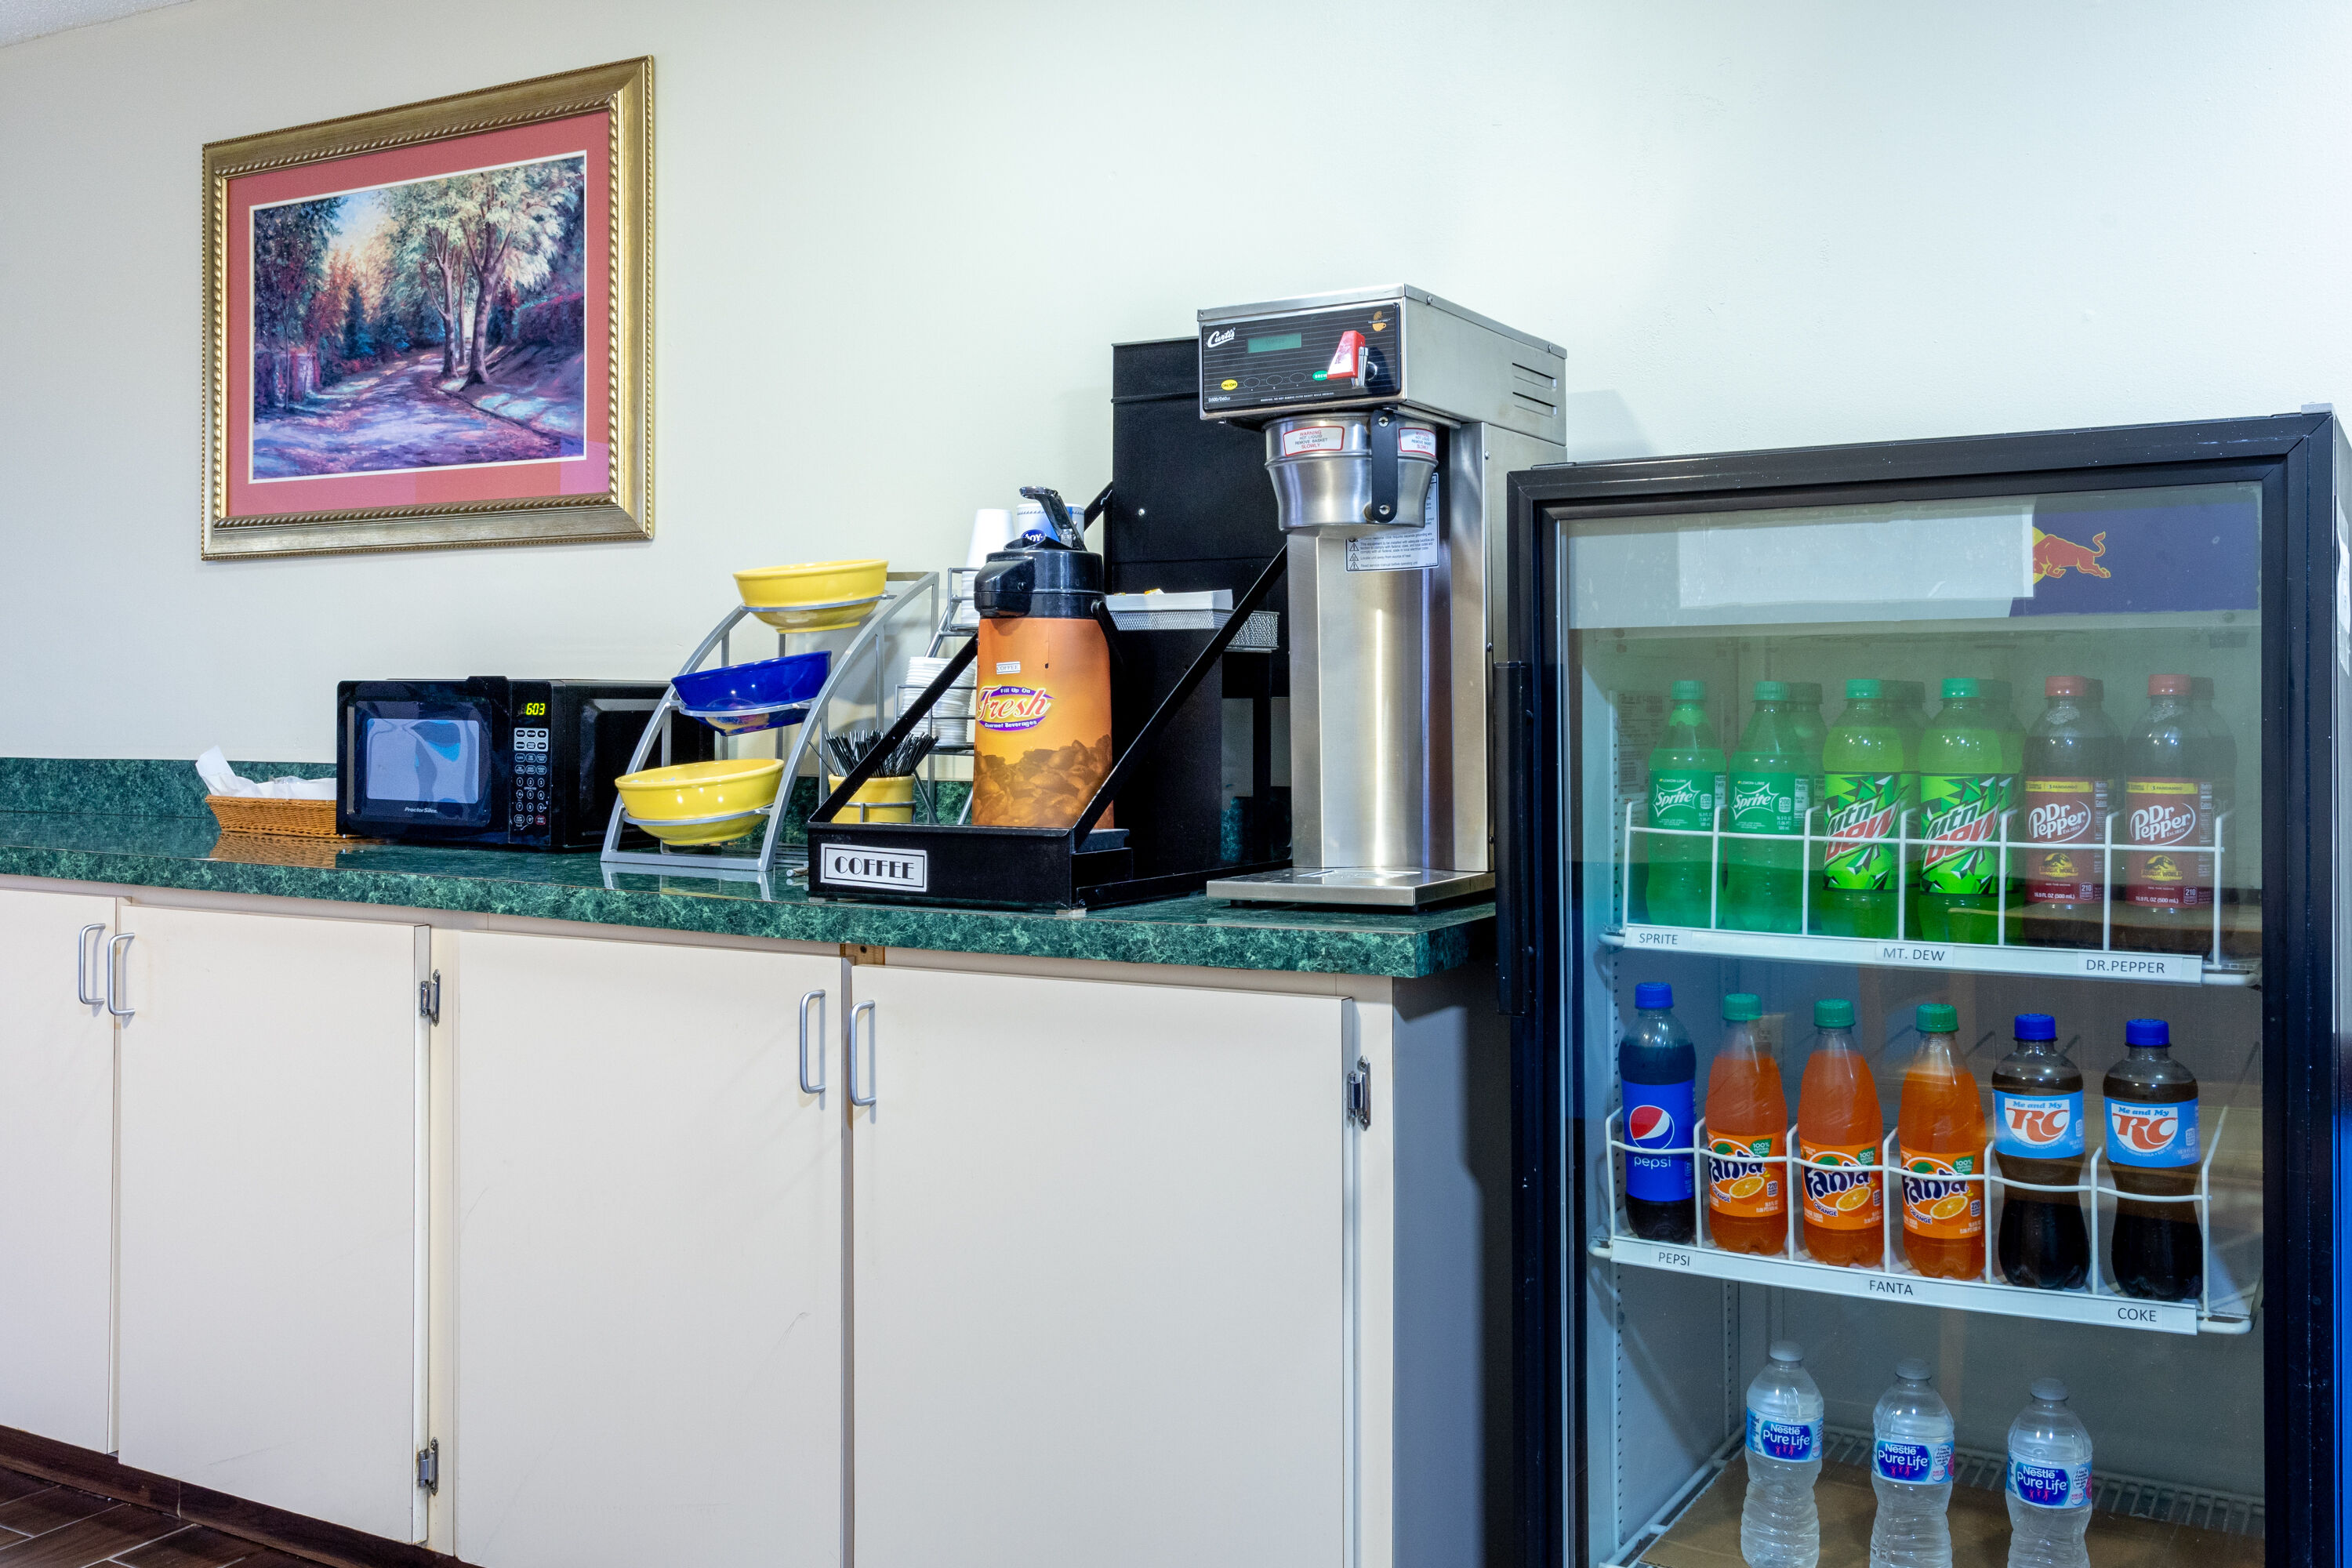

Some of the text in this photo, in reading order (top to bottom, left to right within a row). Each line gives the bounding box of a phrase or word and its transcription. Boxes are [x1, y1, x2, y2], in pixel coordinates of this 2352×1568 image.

[1207, 328, 1235, 347] Curtis
[977, 684, 1051, 721] Fresh
[1655, 790, 1693, 808] Sprite
[1733, 793, 1772, 810] Sprite
[2045, 803, 2071, 822] Dr
[2148, 804, 2175, 825] Dr
[2029, 808, 2086, 839] Pepper
[2130, 809, 2191, 842] Pepper
[834, 855, 915, 880] COFFEE
[1639, 933, 1679, 945] SPRITE
[1883, 947, 1945, 961] MT. DEW
[2086, 959, 2165, 974] DR.PEPPER
[2005, 1107, 2070, 1142] RC
[2112, 1112, 2178, 1150] RC
[1634, 1156, 1671, 1170] pepsi
[1768, 1181, 1777, 1190] 220
[1813, 1201, 1838, 1217] ORANGE
[1971, 1201, 1980, 1210] 220
[1910, 1208, 1933, 1225] ORANGE
[1658, 1251, 1690, 1267] PEPSI
[1869, 1279, 1914, 1296] FANTA
[2118, 1307, 2157, 1322] COKE
[1762, 1429, 1810, 1450] Pure Life
[1878, 1450, 1905, 1465] Pure
[1907, 1455, 1929, 1471] Life
[2016, 1471, 2067, 1495] Pure Life
